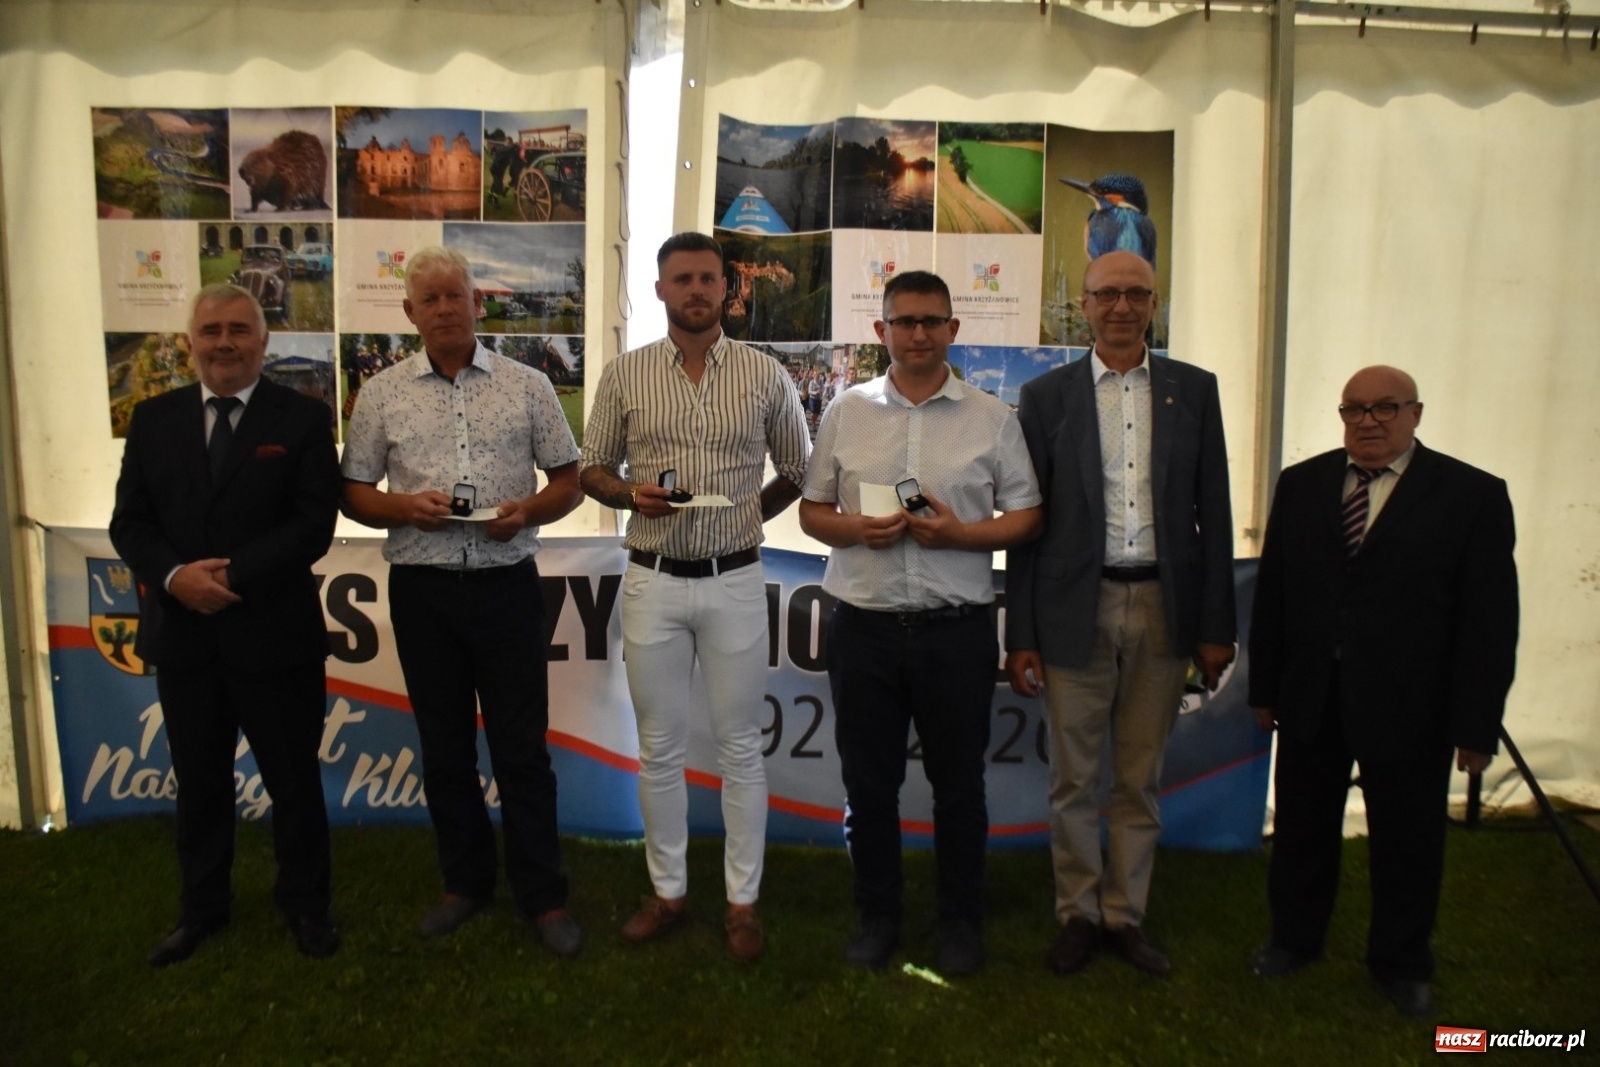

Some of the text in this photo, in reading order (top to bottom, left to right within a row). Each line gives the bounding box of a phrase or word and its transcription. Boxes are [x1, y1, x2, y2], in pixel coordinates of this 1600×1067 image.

[851, 292, 871, 300] GMINA
[952, 295, 1019, 304] GMINA KRZYŻANOWICE
